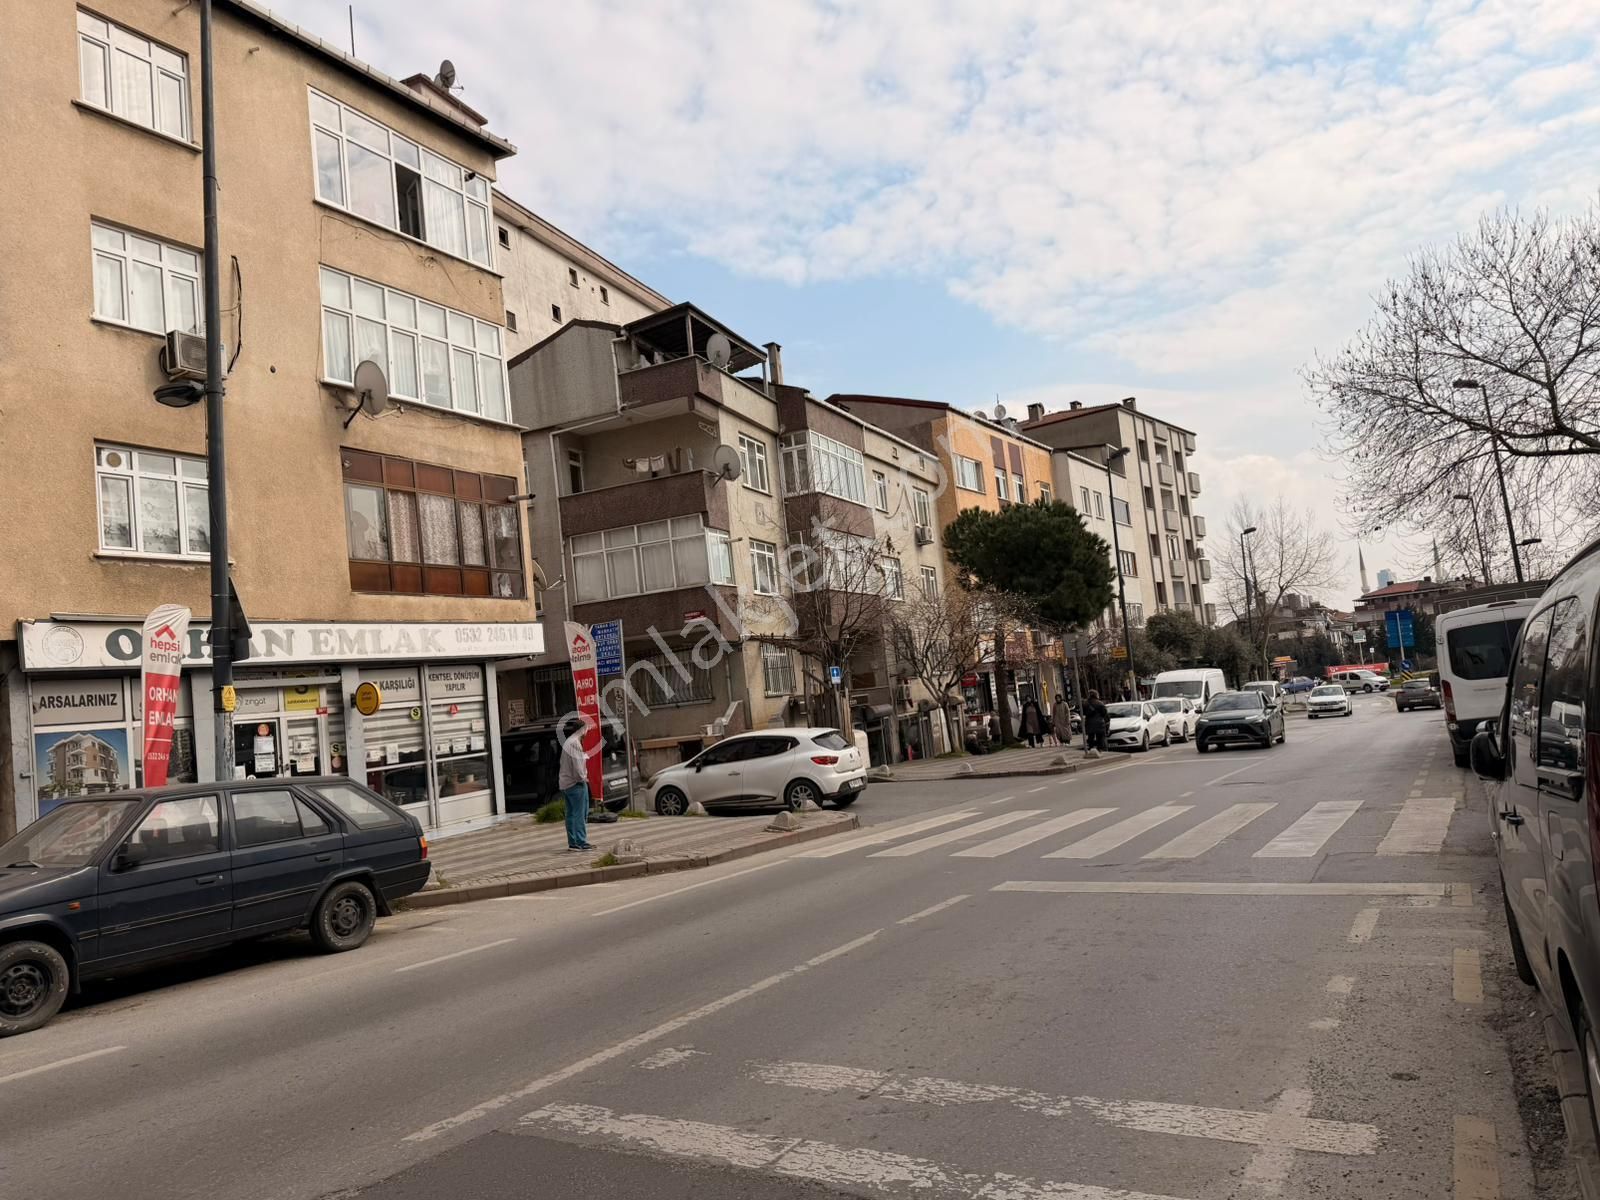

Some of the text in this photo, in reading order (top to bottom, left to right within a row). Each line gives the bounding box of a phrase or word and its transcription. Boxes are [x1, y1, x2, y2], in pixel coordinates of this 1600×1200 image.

[455, 627, 482, 643] 0532
[105, 628, 295, 661] OHN
[308, 628, 446, 656] EMLAK
[150, 637, 180, 653] hepsi
[380, 677, 415, 692] KARŞILIĞI
[428, 671, 480, 682] KENTSEL DÖNÜŞÜM
[444, 682, 466, 692] YAPILIR
[39, 693, 118, 710] ARSALARINIZ
